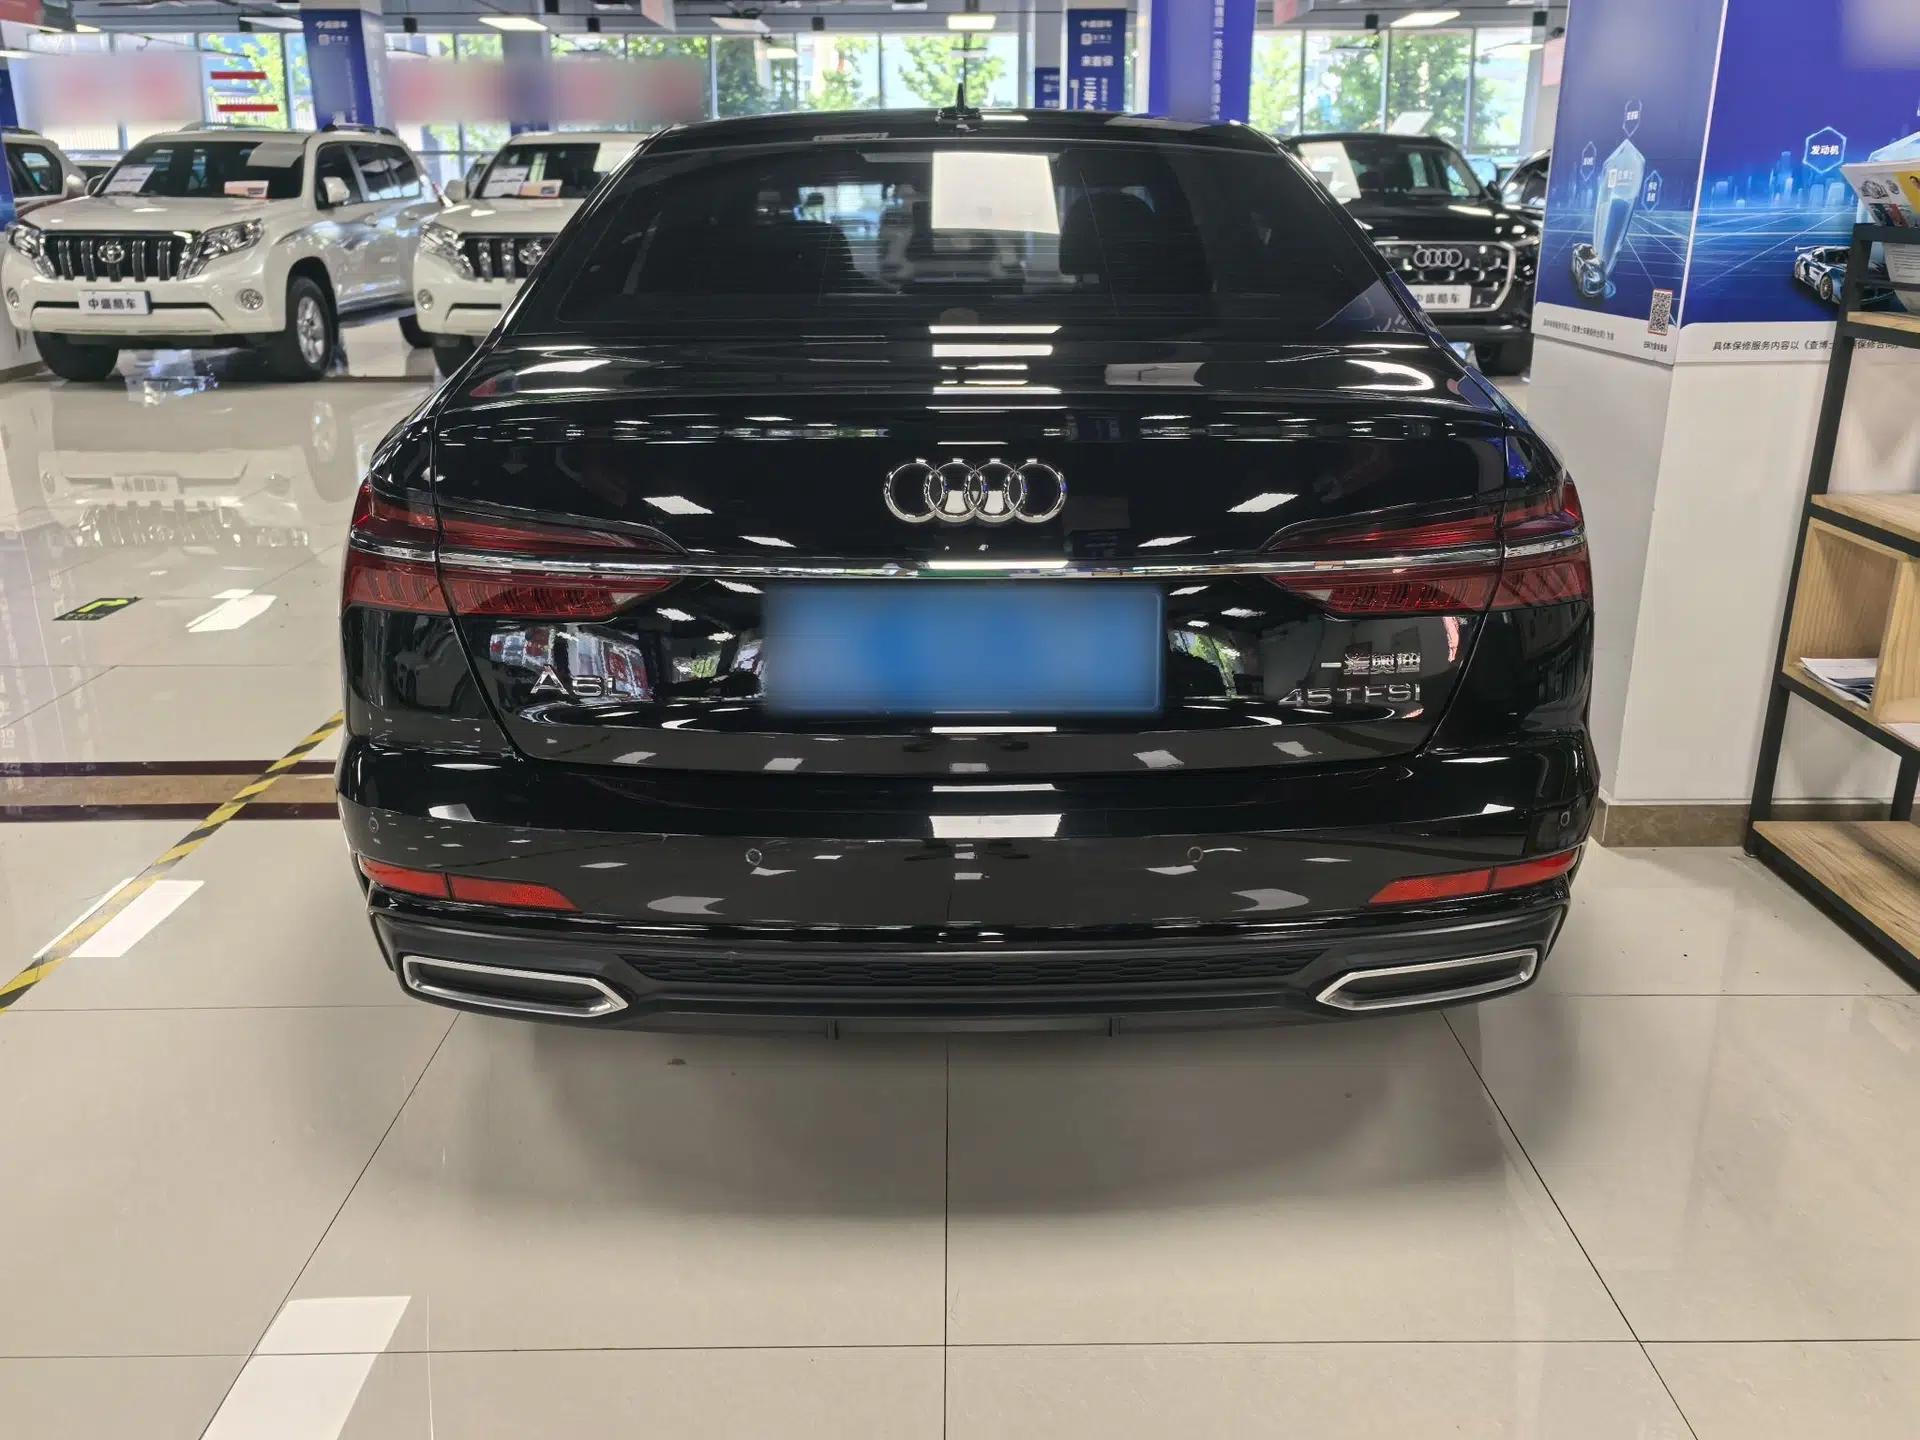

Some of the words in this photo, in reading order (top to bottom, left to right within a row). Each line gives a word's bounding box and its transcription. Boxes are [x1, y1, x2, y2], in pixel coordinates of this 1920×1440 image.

[1810, 144, 1840, 155] 发动机
[530, 665, 632, 697] A6L
